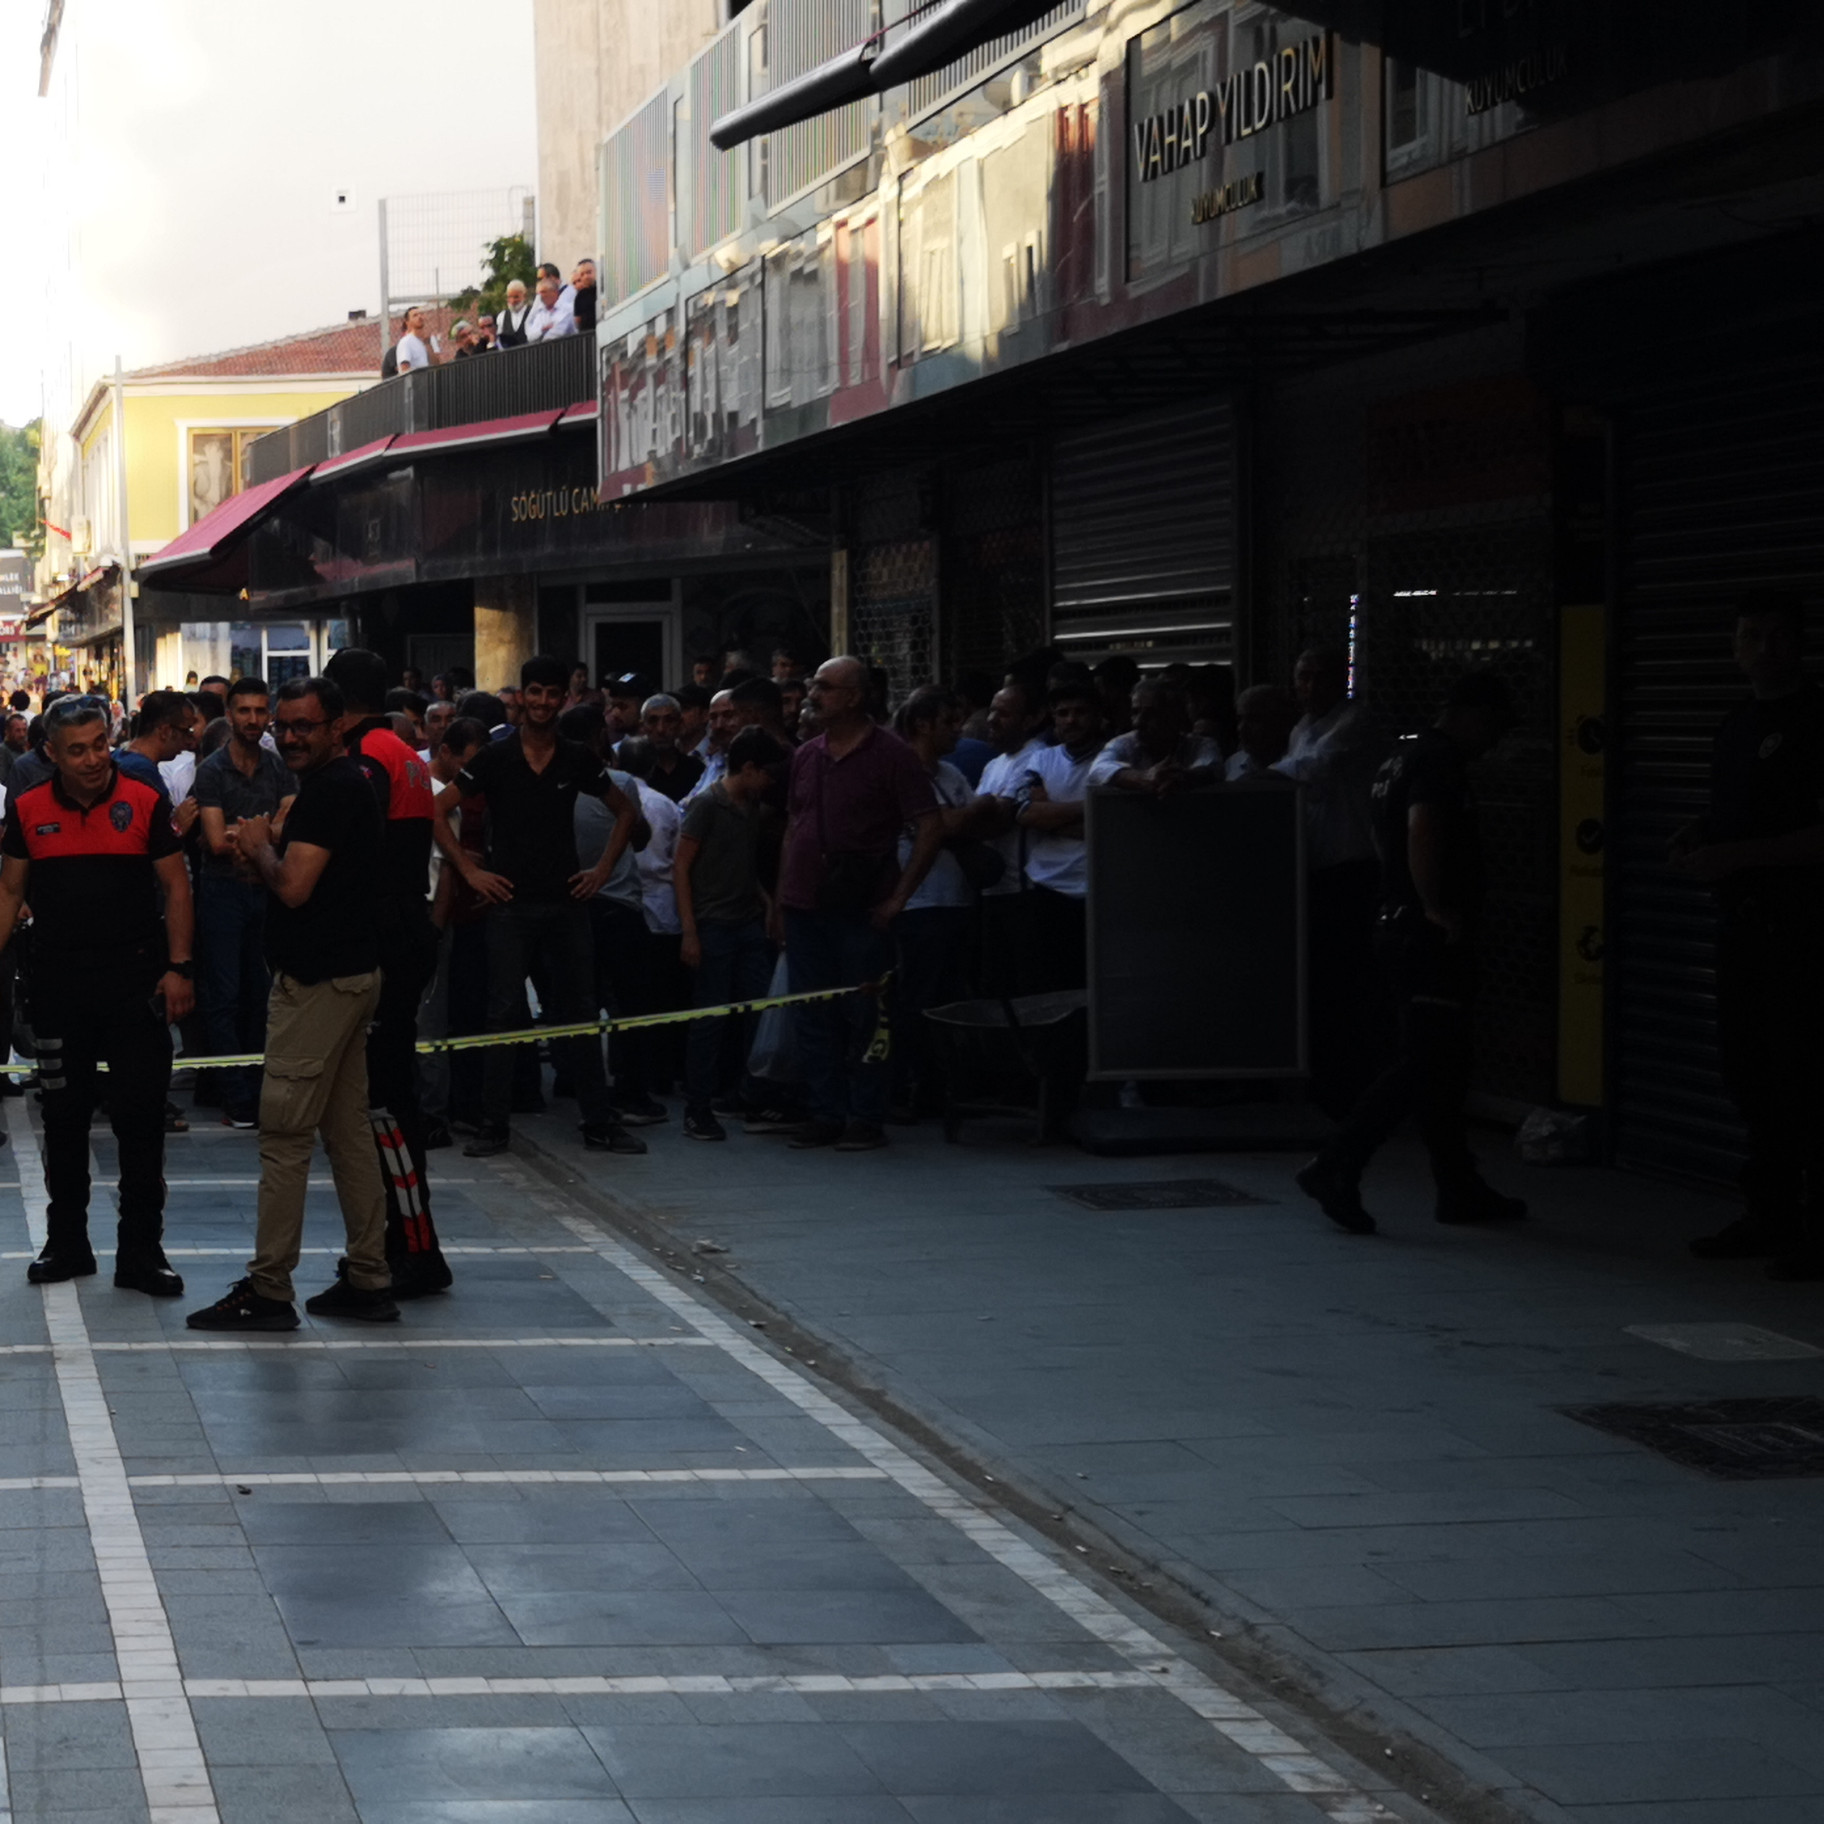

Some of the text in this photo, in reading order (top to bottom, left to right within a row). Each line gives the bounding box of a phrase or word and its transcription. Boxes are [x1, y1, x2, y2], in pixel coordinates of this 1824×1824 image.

[1133, 30, 1332, 182] VAHAP YILDIRIM
[510, 483, 568, 522] SÖĞÜTLÜ
